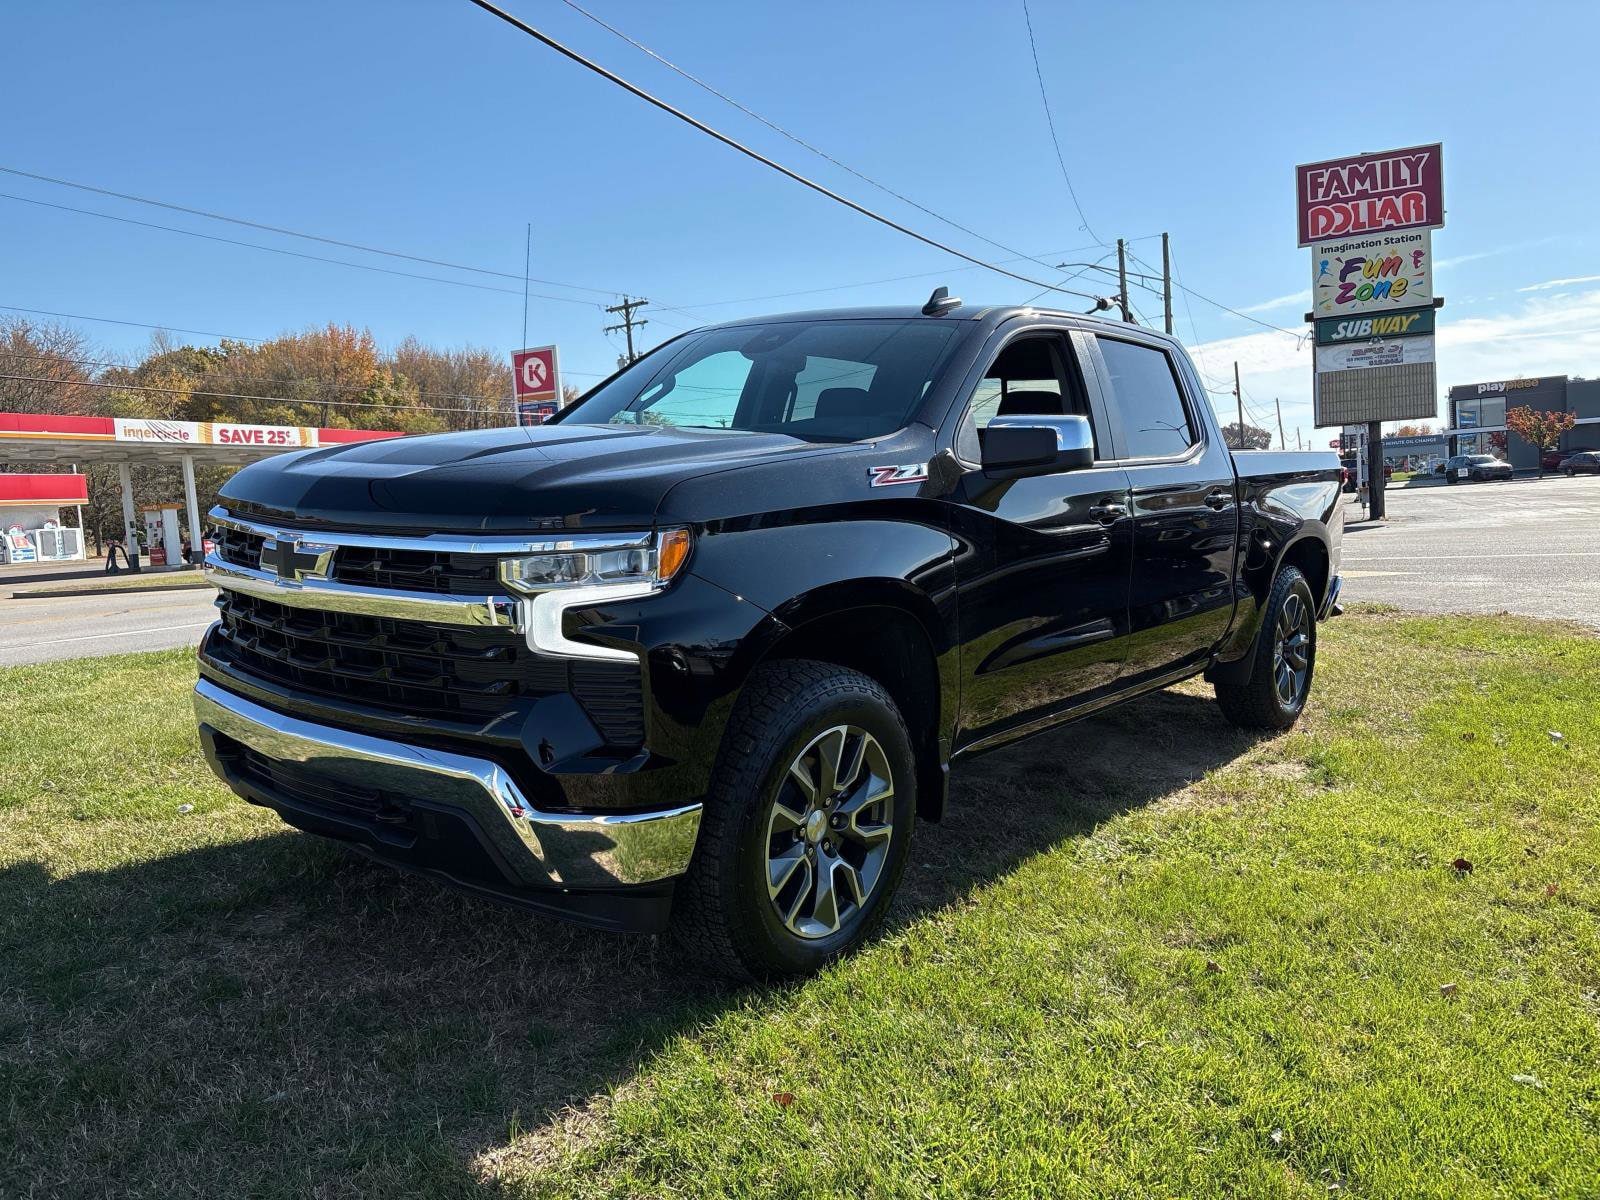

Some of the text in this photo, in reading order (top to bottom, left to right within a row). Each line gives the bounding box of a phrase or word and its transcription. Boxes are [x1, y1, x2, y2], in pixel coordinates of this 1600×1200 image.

[1307, 153, 1430, 202] FAMILY
[1308, 191, 1427, 238] DOLLAR
[1320, 234, 1422, 254] Imagination Station
[1339, 255, 1403, 282] Fun
[1331, 313, 1420, 340] SUBWAY
[527, 362, 546, 386] K
[219, 429, 264, 444] SAVE
[867, 462, 928, 488] Z71
